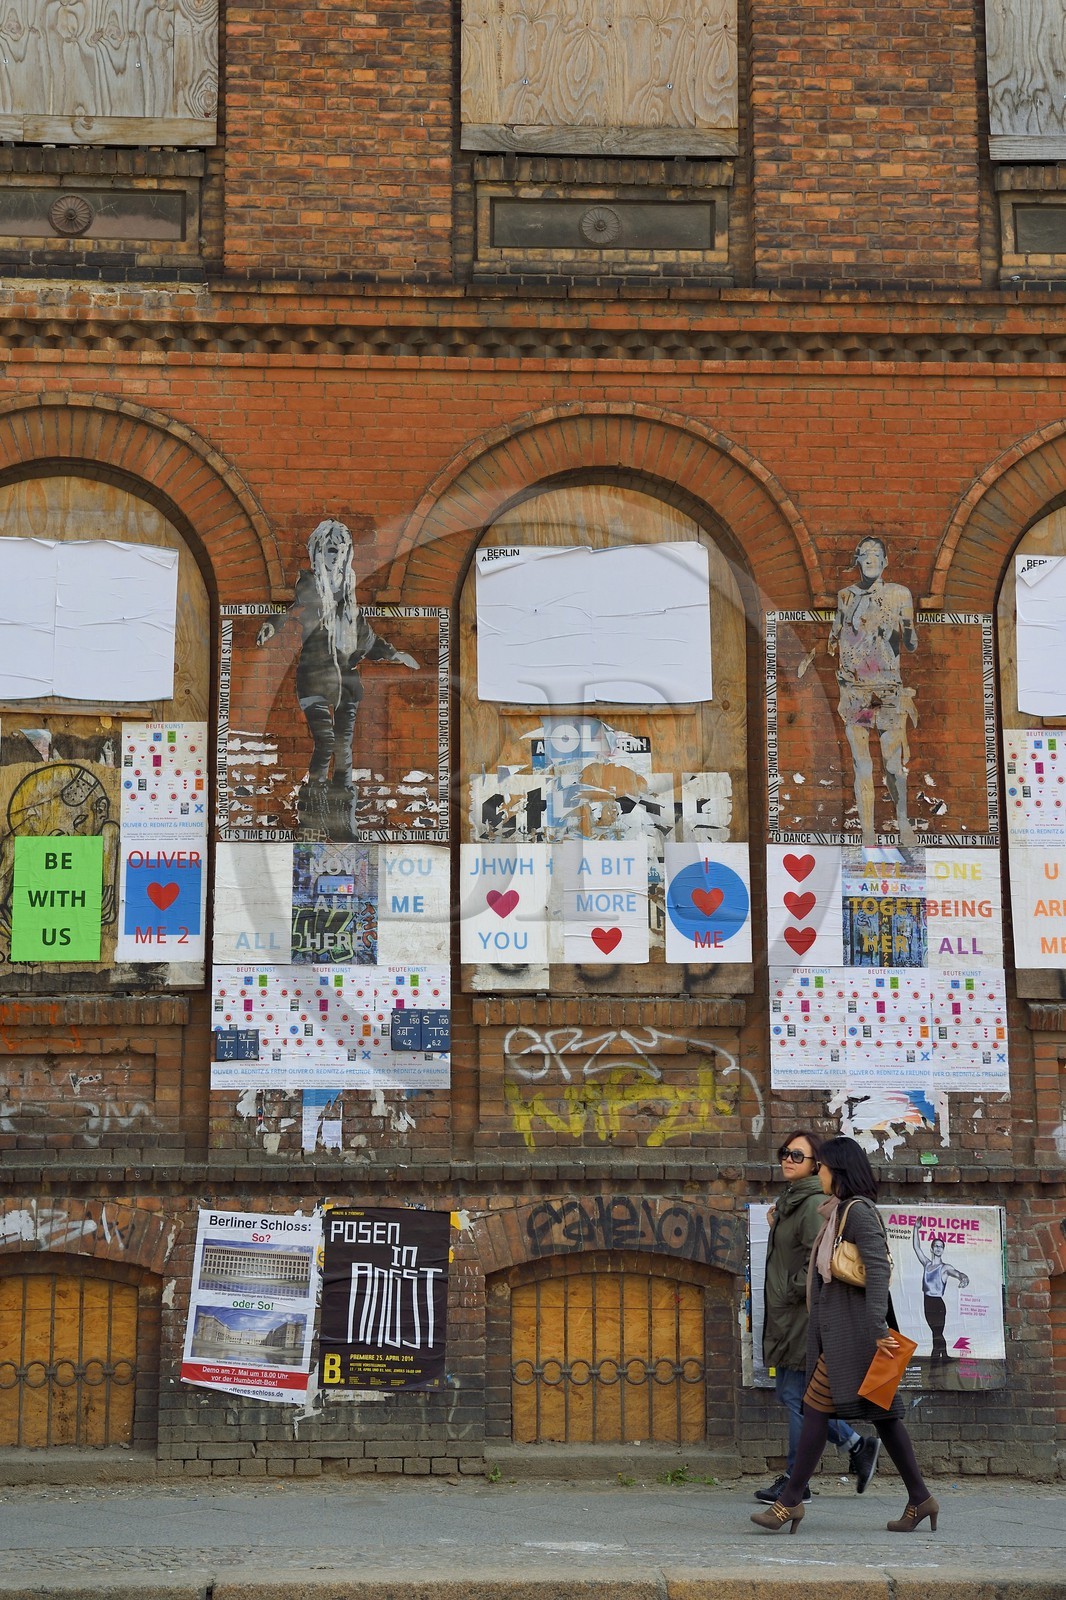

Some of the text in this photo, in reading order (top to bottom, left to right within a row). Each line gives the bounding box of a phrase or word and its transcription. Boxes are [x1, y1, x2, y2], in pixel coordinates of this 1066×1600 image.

[487, 549, 520, 557] BERLIN
[222, 605, 287, 615] TIME TO DANCE
[404, 608, 420, 617] IT'S
[778, 611, 806, 621] DANCE
[918, 614, 946, 623] DANCE
[964, 614, 979, 624] IT'S
[439, 622, 449, 650] DANCE
[766, 618, 776, 638] TIME
[982, 625, 992, 636] TO
[766, 640, 776, 652] TO
[982, 638, 993, 666] DANCE
[440, 667, 449, 683] IT'S
[766, 653, 777, 680] DANCE
[439, 685, 449, 705] TIME
[984, 684, 994, 699] IT'S
[439, 707, 449, 718] TO
[767, 698, 777, 714] IT'S
[984, 701, 995, 721] TIME
[217, 639, 232, 820] IT'S TIME TO DANCE IT'S TIME TO DANCE
[439, 720, 449, 748] DANCE
[767, 716, 777, 736] TIME
[985, 723, 996, 734] TO
[768, 738, 778, 749] TO
[986, 736, 996, 764] DANCE
[768, 750, 778, 778] DANCE
[438, 766, 448, 781] IT'S
[439, 784, 449, 803] TIME
[987, 782, 997, 797] IT'S
[438, 806, 449, 818] TO
[769, 797, 778, 812] IT'S
[988, 800, 998, 820] TIME
[224, 830, 276, 840] IT'S TIME TO
[392, 830, 407, 840] IT'S
[410, 830, 430, 840] TIME
[989, 822, 999, 832] TO
[784, 833, 811, 843] DANCE
[830, 834, 845, 844] IT'S
[884, 835, 895, 844] TO
[961, 836, 1000, 845] IT'S TIME
[44, 852, 73, 870] BE
[128, 850, 201, 869] OLIVER
[310, 856, 369, 876] NOW
[383, 858, 433, 876] YOU
[470, 858, 534, 876] JHWH
[578, 858, 635, 875] A BIT
[863, 861, 906, 878] ALL
[934, 862, 982, 880] ONE
[1044, 863, 1059, 880] U
[28, 890, 86, 908] WITH
[313, 895, 359, 912] ALL
[391, 896, 424, 913] ME
[576, 894, 636, 912] MORE
[849, 897, 920, 916] TOGET
[927, 900, 993, 918] BEING
[42, 928, 72, 946] US
[135, 926, 189, 944] ME 2
[236, 932, 280, 950] ALL
[306, 932, 364, 950] HERE
[478, 932, 528, 950] YOU
[694, 931, 724, 948] ME
[863, 935, 908, 953] HER
[938, 938, 984, 955] ALL
[394, 1015, 401, 1024] S
[422, 1016, 430, 1025] S
[209, 1215, 312, 1232] Berliner Schloss:
[888, 1214, 980, 1231] ABENDLICHE
[251, 1233, 272, 1243] So?
[330, 1221, 400, 1244] POSEN
[918, 1228, 966, 1244] TÄNZE
[391, 1246, 418, 1267] IN
[232, 1300, 274, 1310] oder So!
[347, 1262, 443, 1349] ANGST
